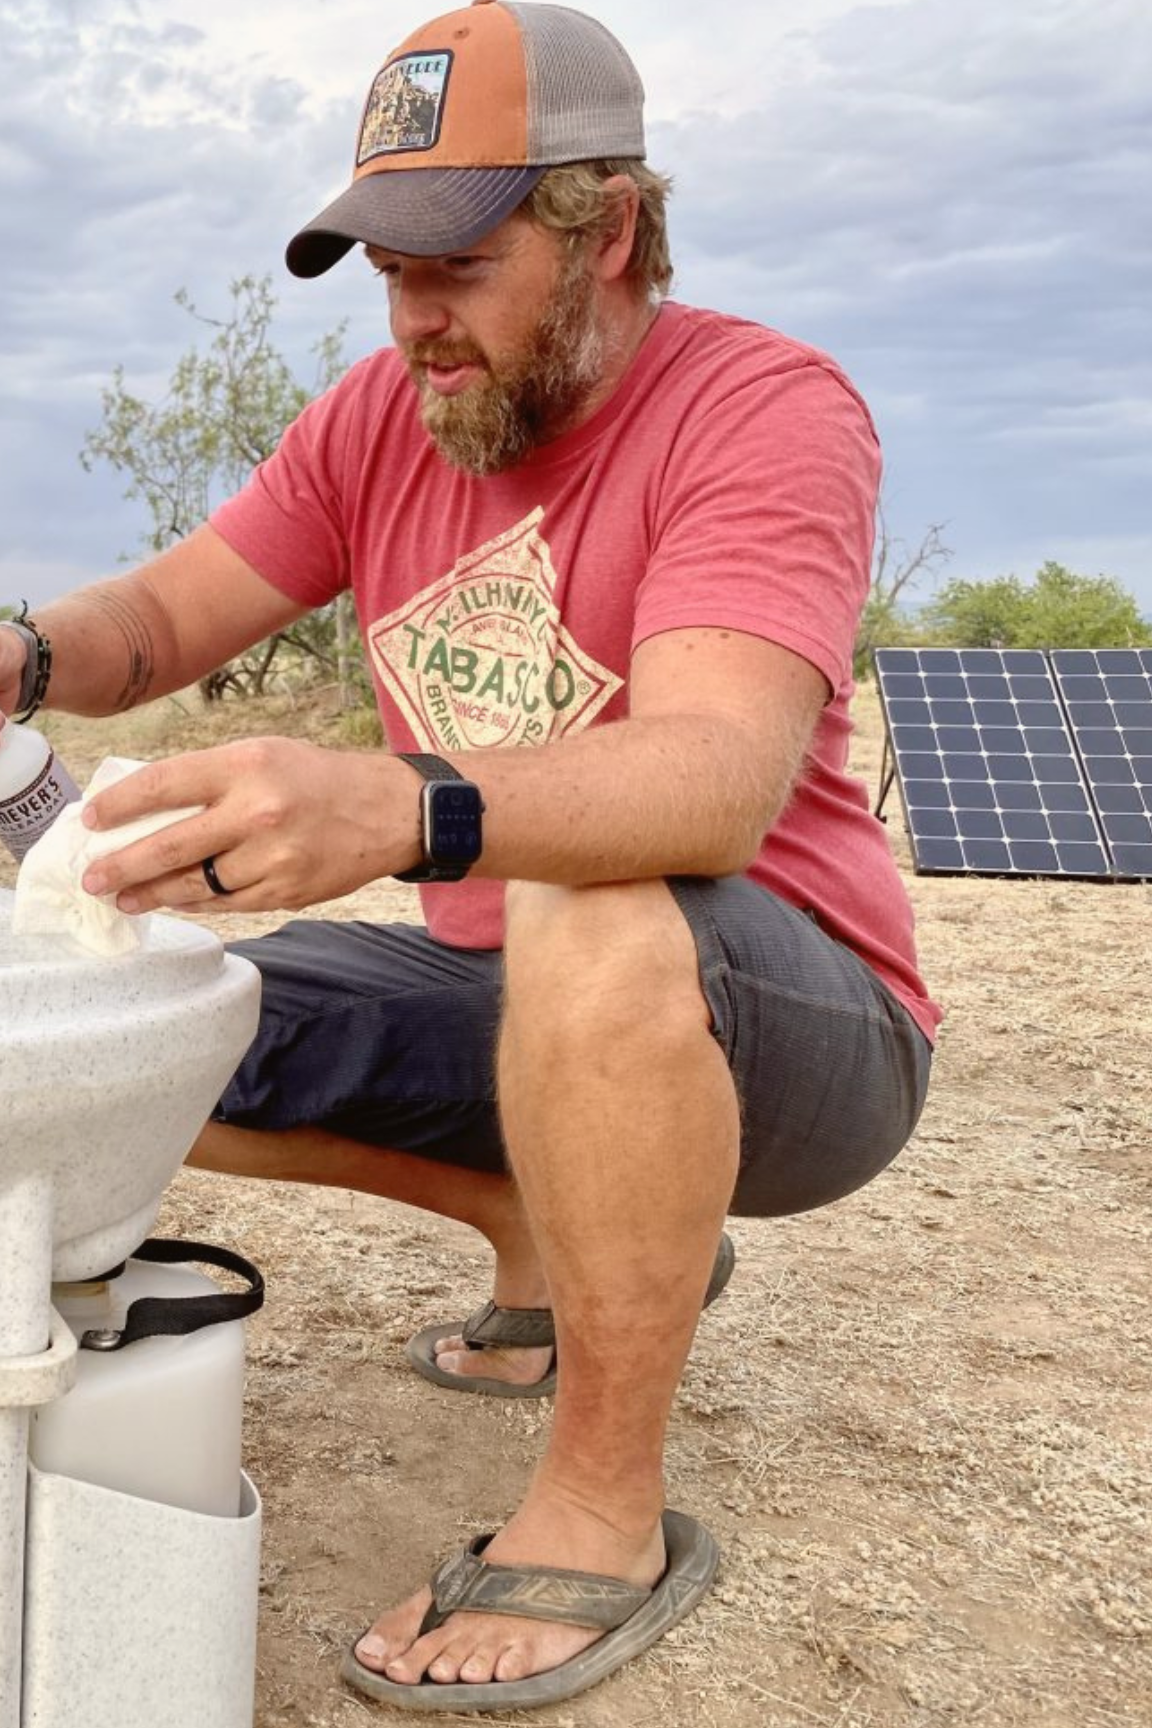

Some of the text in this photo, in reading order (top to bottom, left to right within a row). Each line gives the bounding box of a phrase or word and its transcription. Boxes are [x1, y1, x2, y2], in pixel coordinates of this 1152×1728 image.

[436, 582, 547, 636] MILHNY
[403, 623, 576, 713] TABASCO
[453, 699, 489, 722] SINCE
